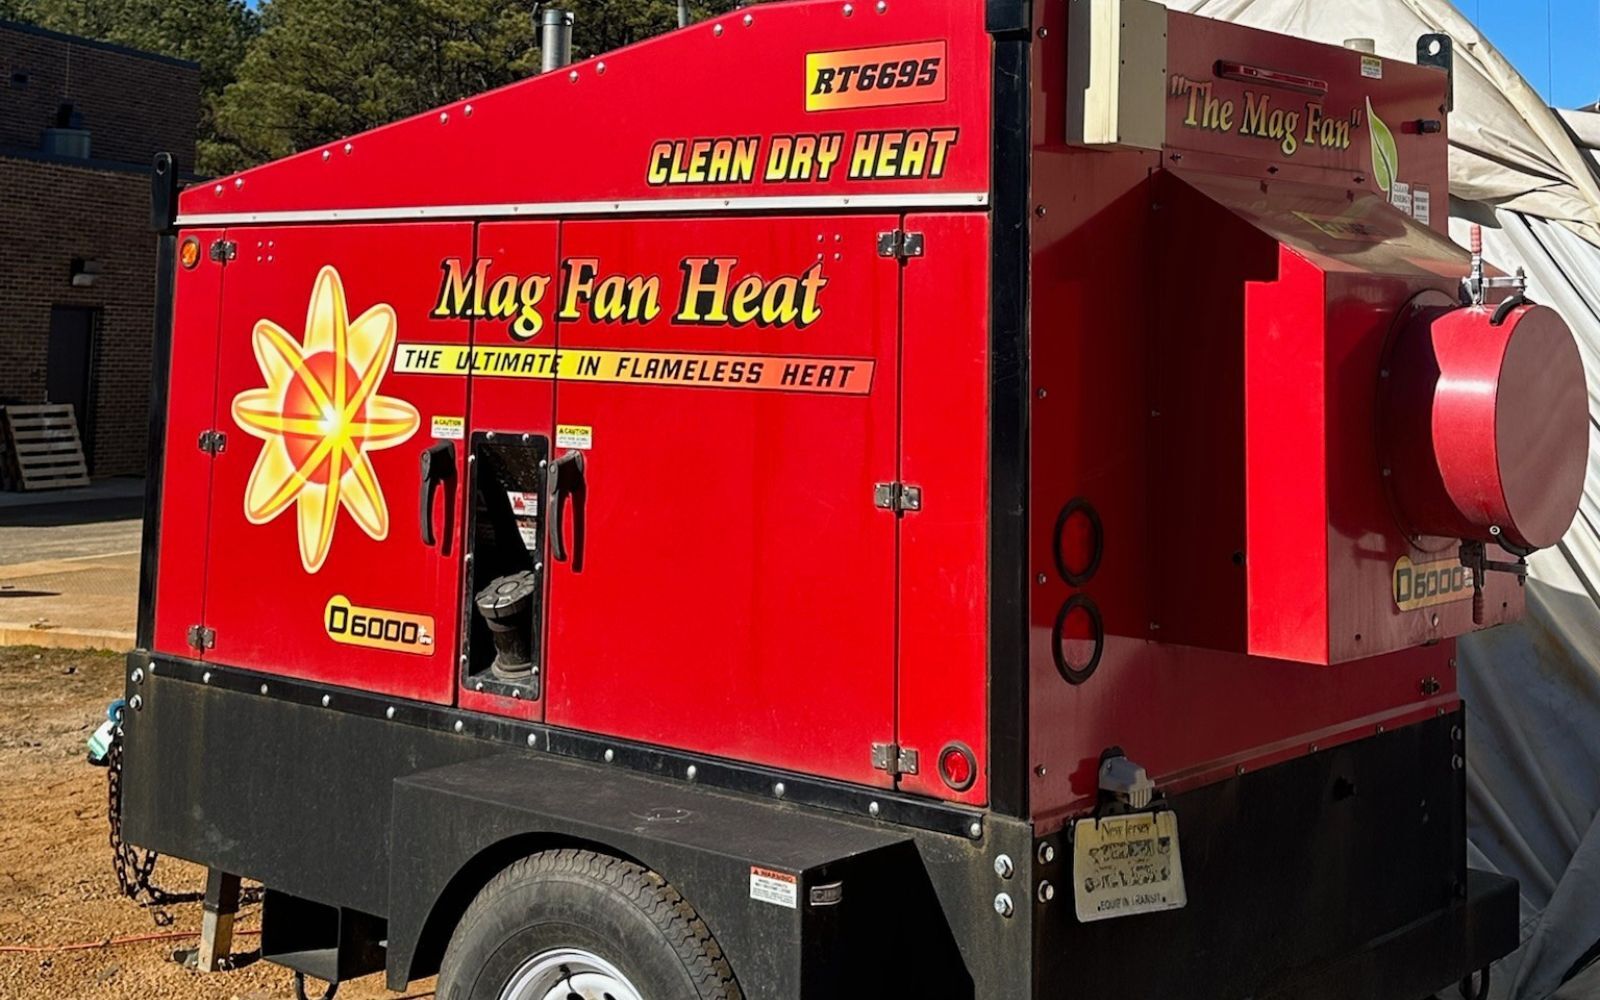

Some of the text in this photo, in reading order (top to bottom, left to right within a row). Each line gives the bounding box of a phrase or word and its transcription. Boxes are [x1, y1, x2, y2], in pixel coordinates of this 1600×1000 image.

[811, 57, 941, 96] RT6695
[1239, 91, 1299, 156] Mag
[647, 127, 960, 187] CLEAN DRY HEAT
[430, 257, 829, 341] Mag Fan Heat
[404, 349, 856, 389] THE ULTIMATE IN FLAMELESS HEAT
[440, 418, 462, 427] CAUTION
[563, 427, 589, 436] CAUTION
[760, 868, 793, 884] WARNING
